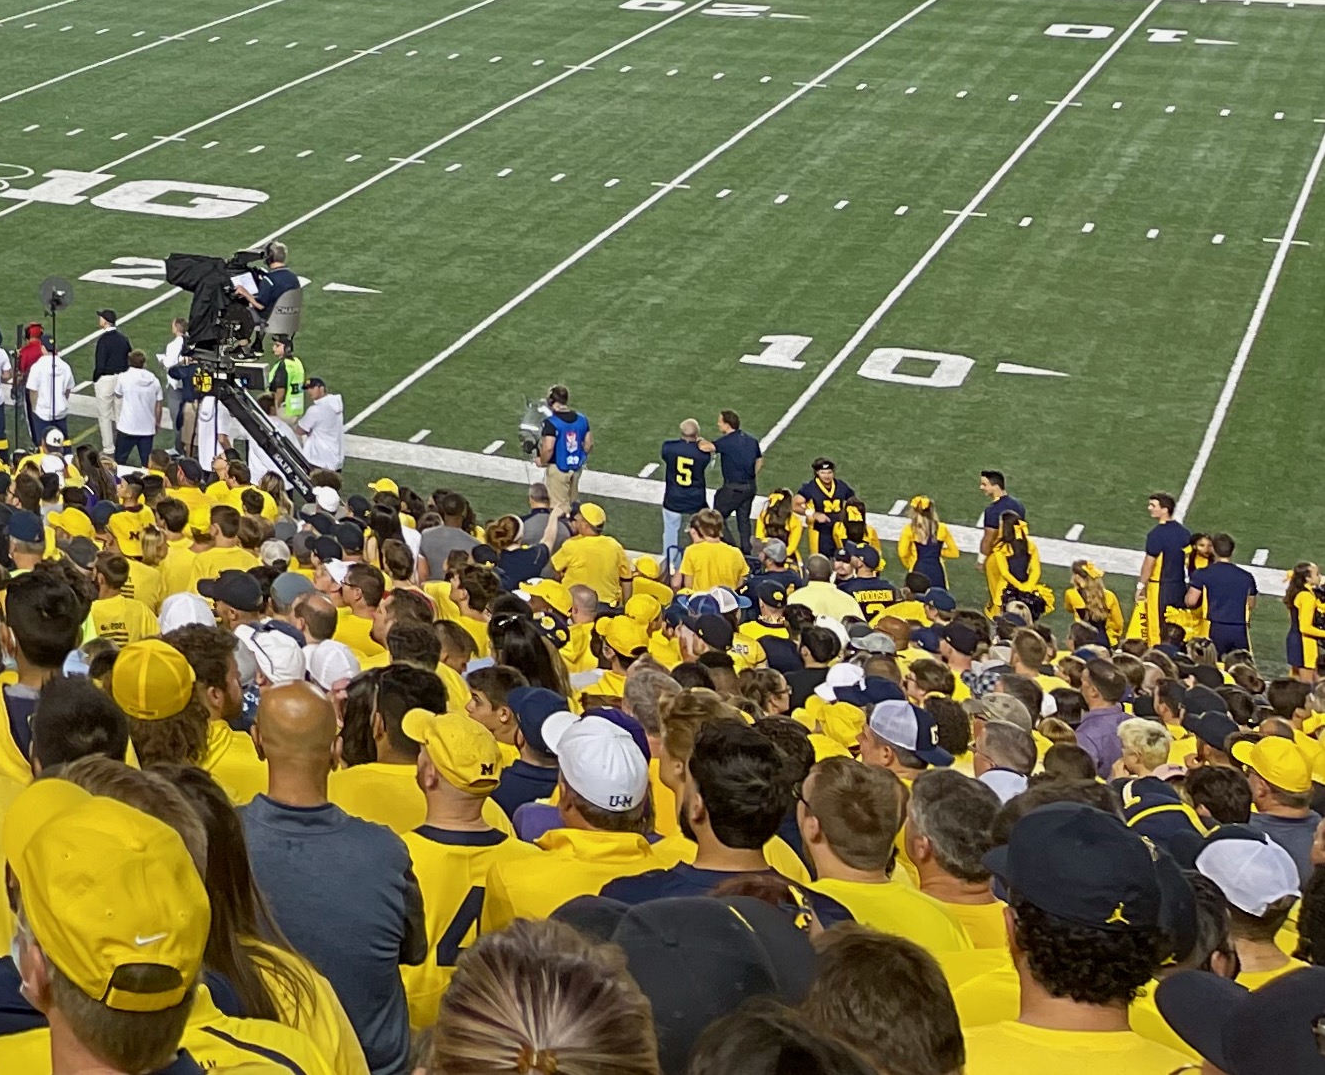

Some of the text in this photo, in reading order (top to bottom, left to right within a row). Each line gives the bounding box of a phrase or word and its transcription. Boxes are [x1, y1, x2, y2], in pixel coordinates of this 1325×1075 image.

[1043, 23, 1190, 43] 10
[739, 333, 977, 388] 10
[675, 455, 694, 486] 5
[822, 498, 842, 513] M
[480, 763, 494, 777] M
